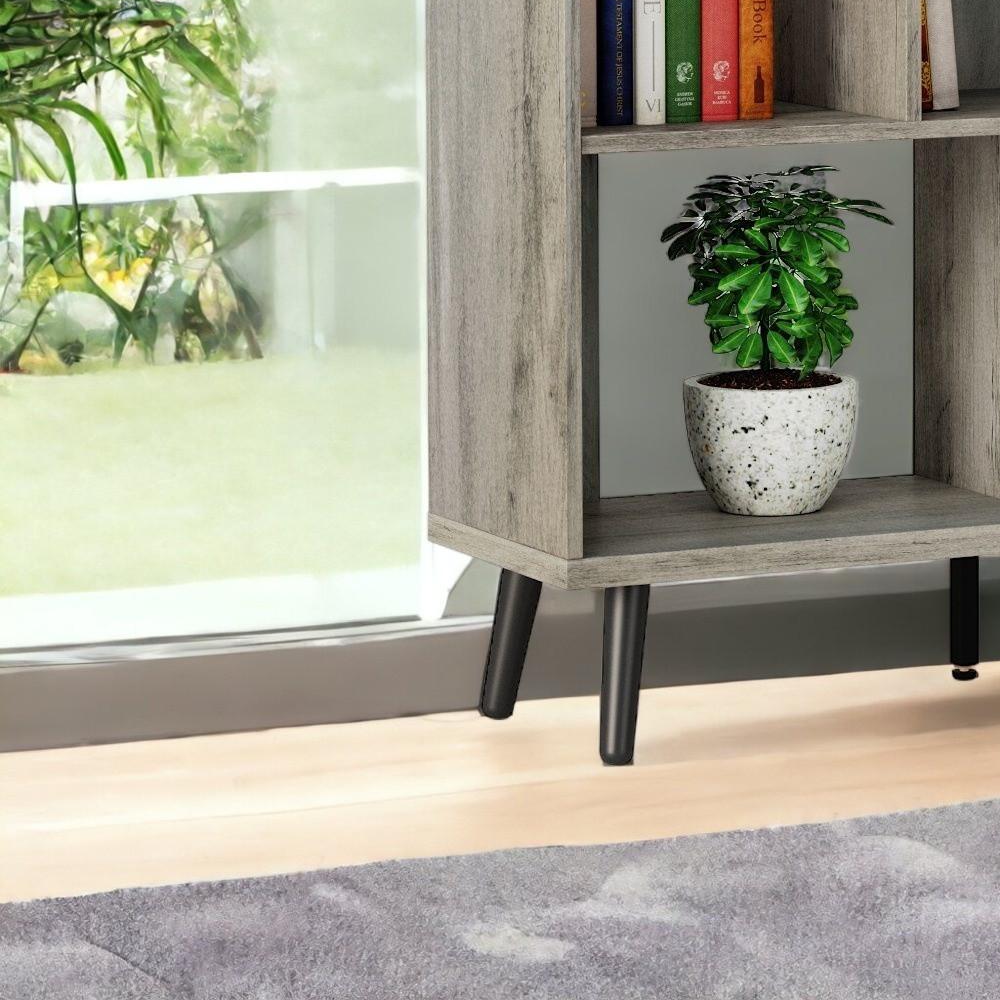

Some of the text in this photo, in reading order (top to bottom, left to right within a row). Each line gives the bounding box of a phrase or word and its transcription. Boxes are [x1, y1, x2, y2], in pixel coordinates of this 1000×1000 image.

[615, 3, 623, 49] TESTAMENT
[753, 0, 767, 44] Book
[615, 63, 623, 87] JESUS
[615, 87, 623, 117] CHRIST
